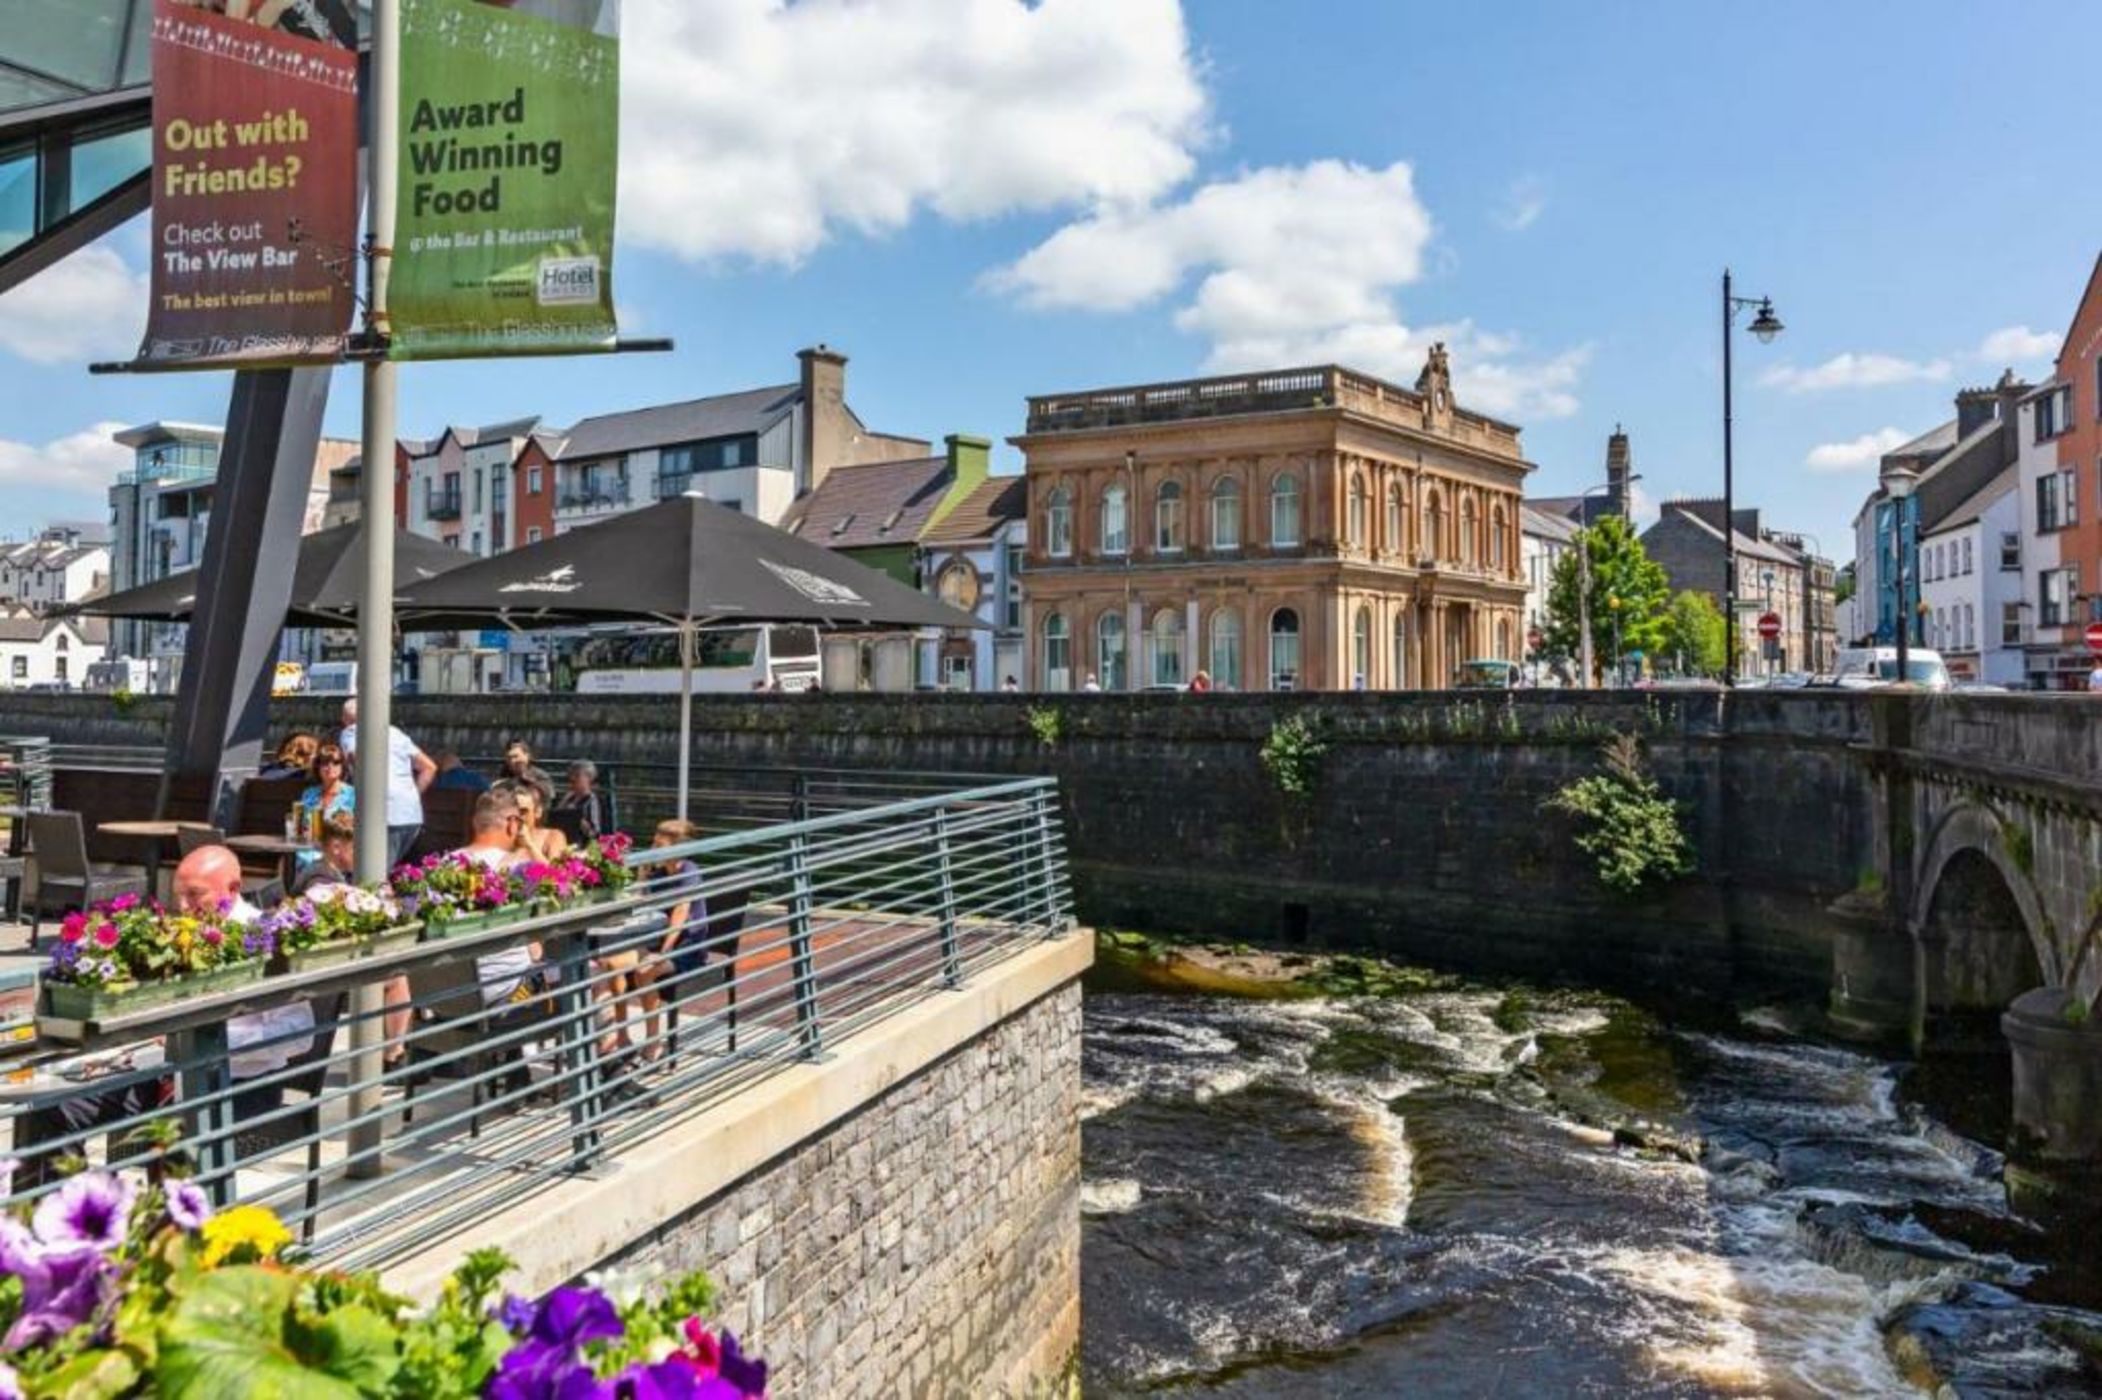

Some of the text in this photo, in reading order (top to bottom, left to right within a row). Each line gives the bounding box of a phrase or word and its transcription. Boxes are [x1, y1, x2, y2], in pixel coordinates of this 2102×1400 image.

[166, 108, 309, 151] Out with
[410, 87, 524, 133] Award
[410, 132, 562, 175] Winning
[165, 155, 302, 197] Friends?
[413, 175, 500, 217] Food
[163, 221, 263, 245] Check out
[164, 246, 298, 272] The View Bar
[542, 266, 595, 286] Hotel
[162, 294, 192, 311] The
[195, 291, 229, 309] best
[230, 289, 268, 306] view
[270, 287, 284, 304] in
